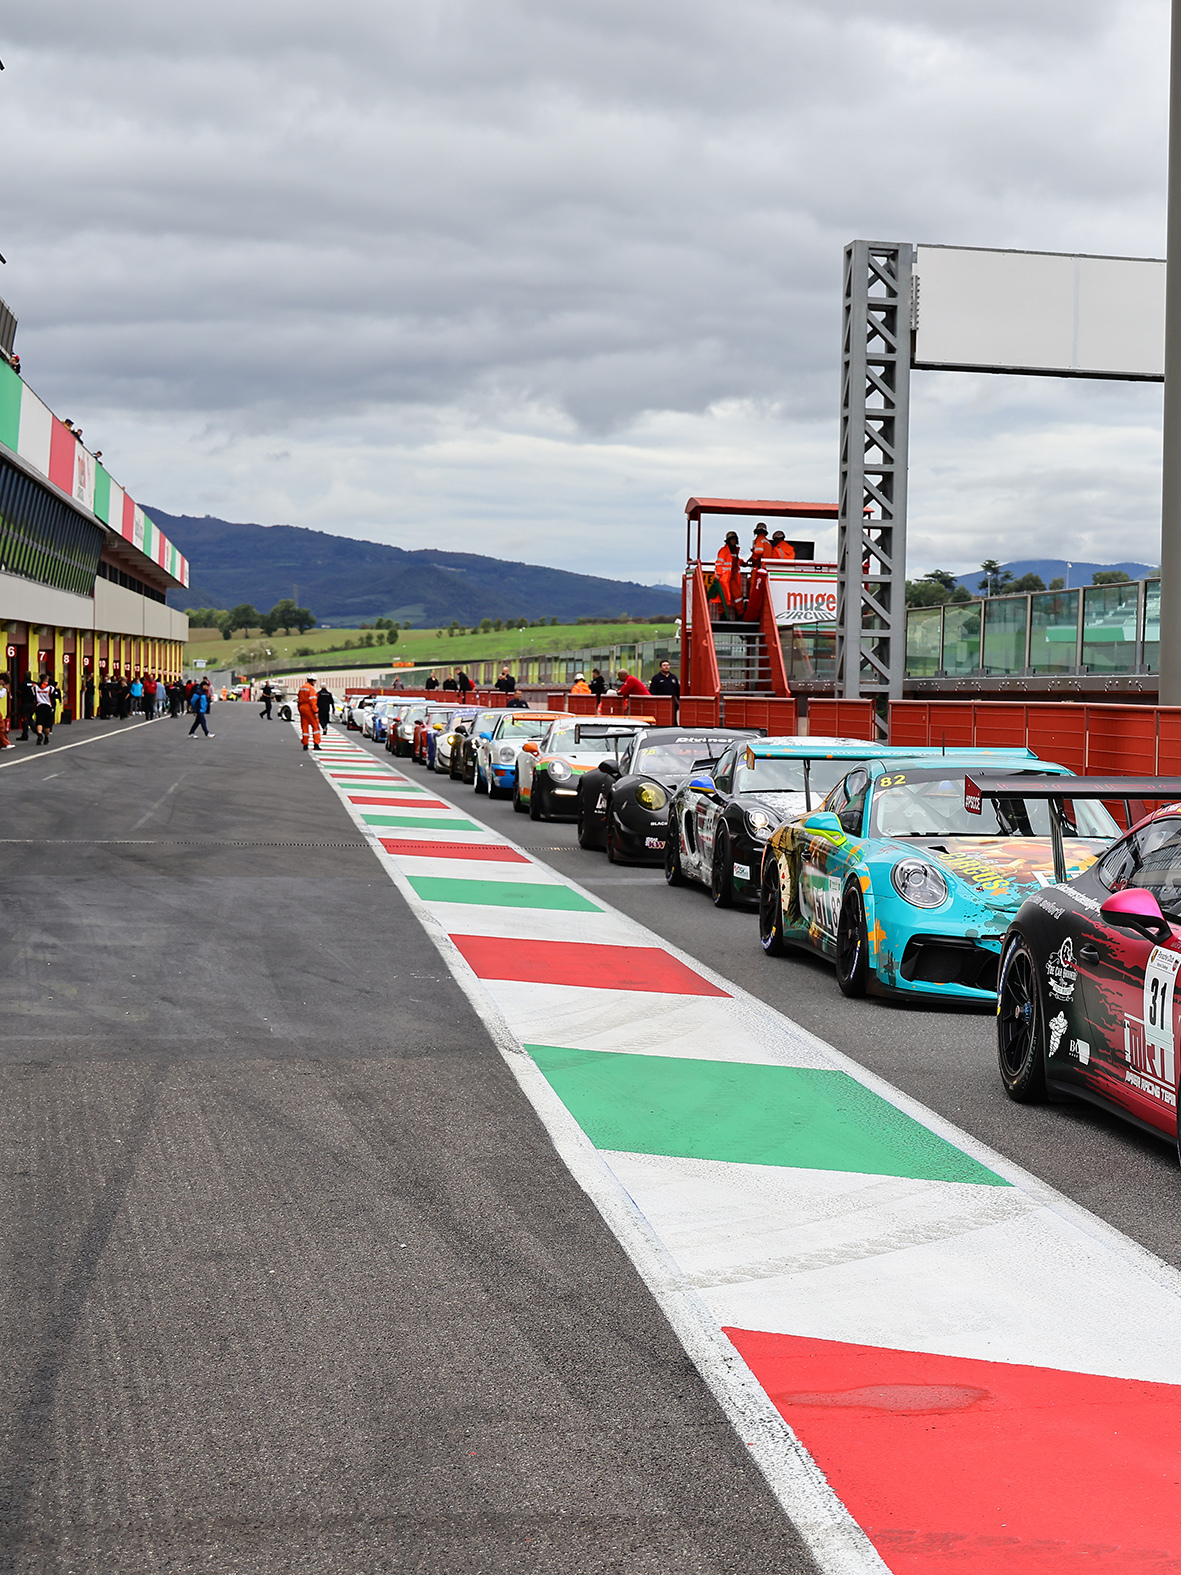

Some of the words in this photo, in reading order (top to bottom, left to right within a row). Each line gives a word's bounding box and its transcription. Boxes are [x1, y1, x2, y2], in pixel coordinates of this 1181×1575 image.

[787, 592, 837, 612] muge
[7, 646, 15, 657] 6
[39, 651, 46, 661] 7
[64, 655, 70, 664] 8
[84, 657, 90, 666] 9
[880, 775, 907, 788] 82
[939, 852, 1010, 890] CIRCUS
[1148, 978, 1168, 1031] 31
